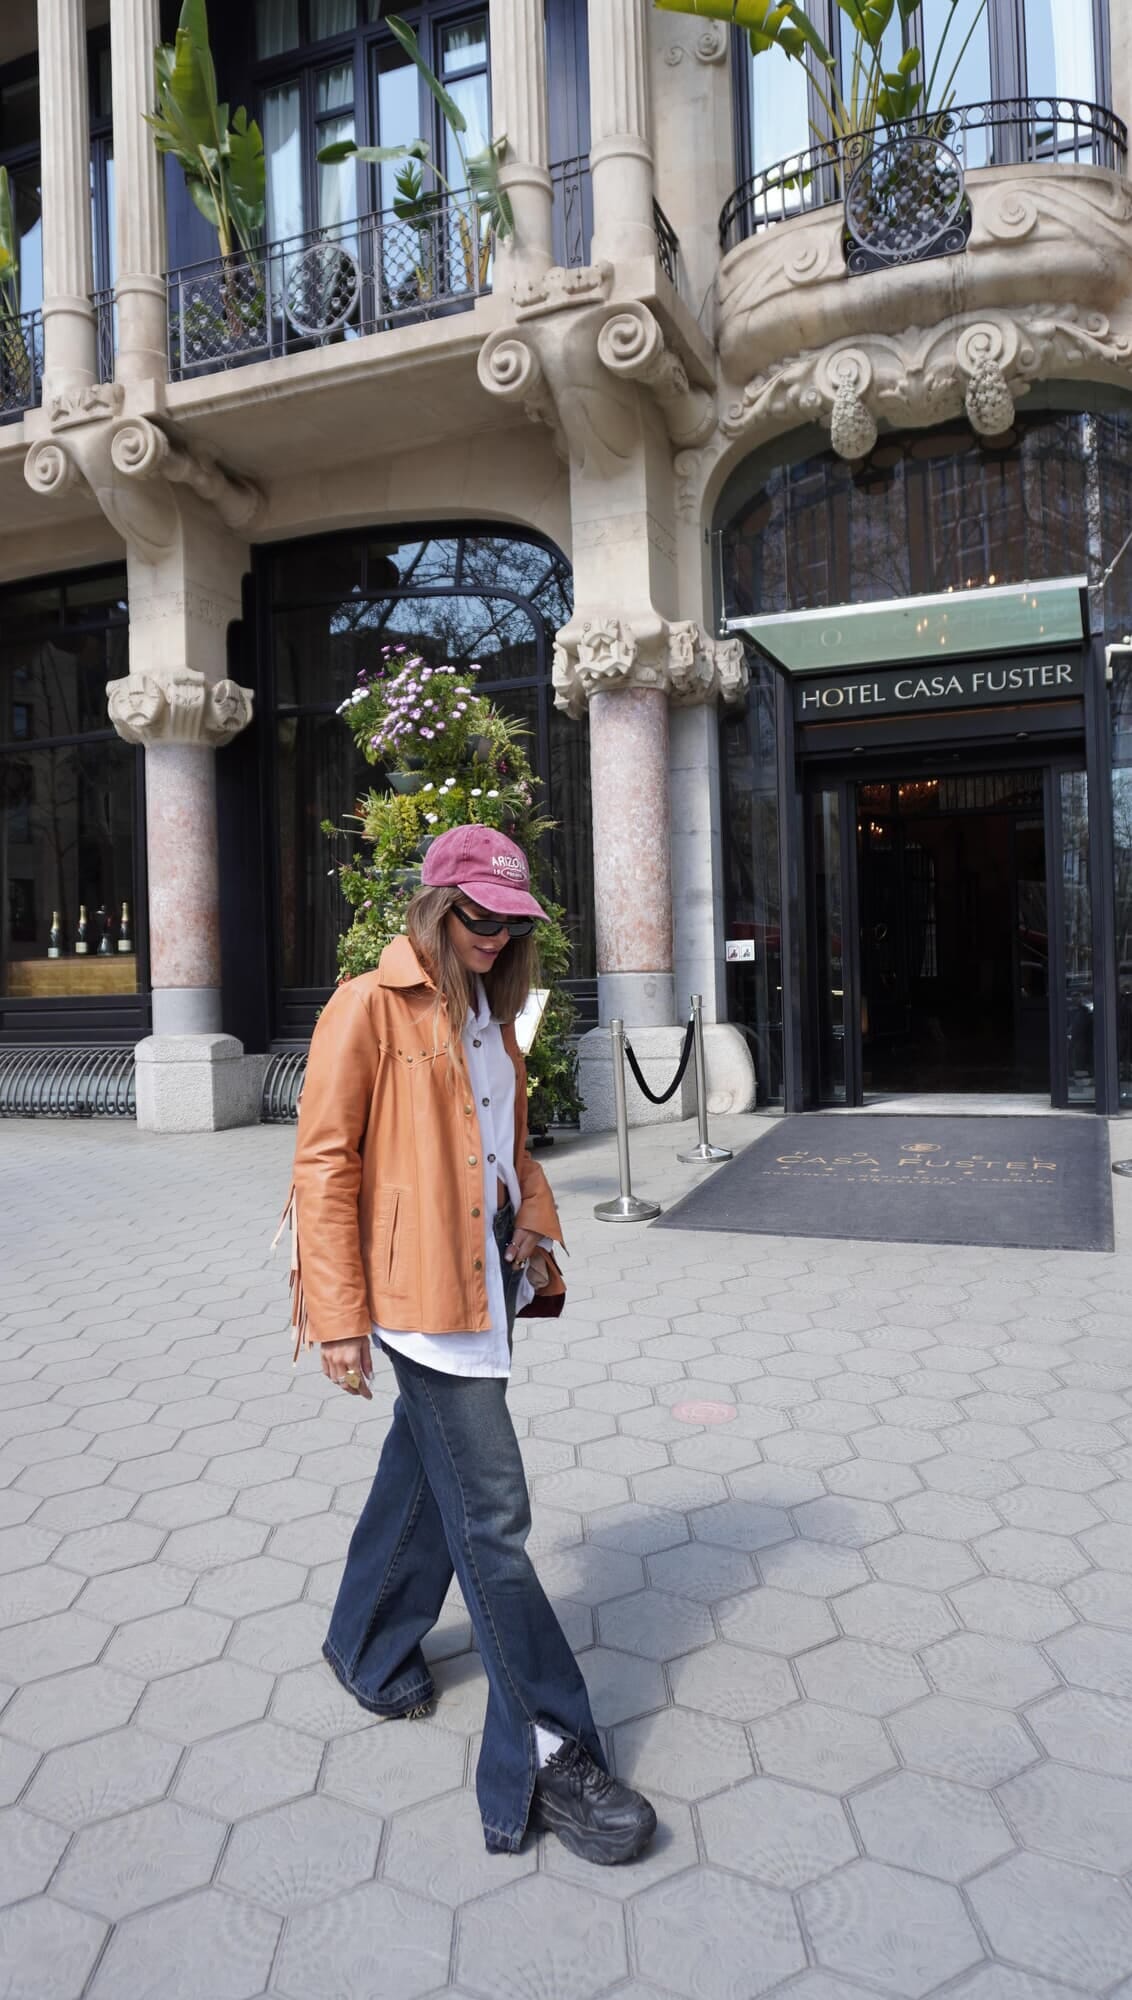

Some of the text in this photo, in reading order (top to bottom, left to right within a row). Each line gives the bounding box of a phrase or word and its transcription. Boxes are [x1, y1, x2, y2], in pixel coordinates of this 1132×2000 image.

[801, 663, 1074, 710] HOTEL CASA FUSTER
[492, 855, 526, 870] ARIZO
[776, 1155, 1057, 1170] CASA FUSTER
